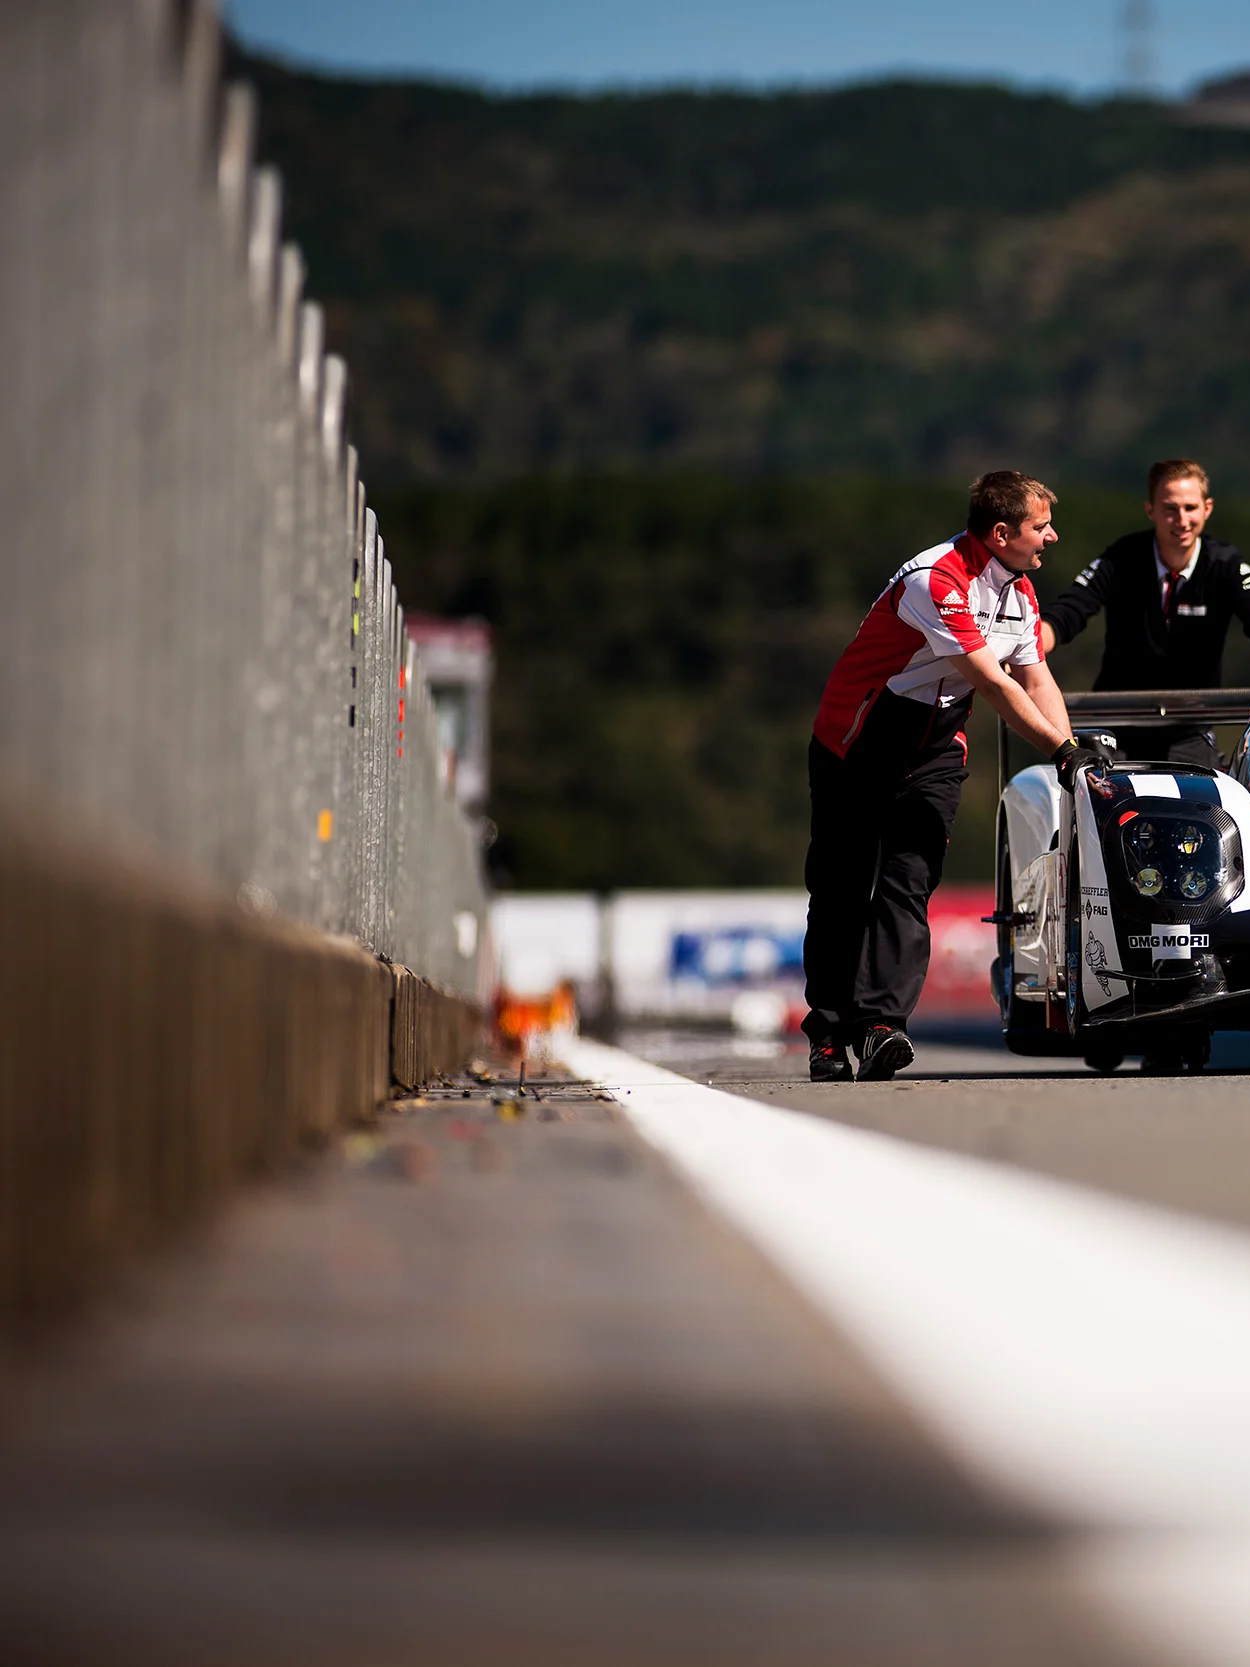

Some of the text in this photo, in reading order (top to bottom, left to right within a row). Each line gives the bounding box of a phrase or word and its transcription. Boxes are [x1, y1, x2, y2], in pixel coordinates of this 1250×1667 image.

[1093, 905, 1108, 916] FAG
[1130, 935, 1208, 948] DMG MORI
